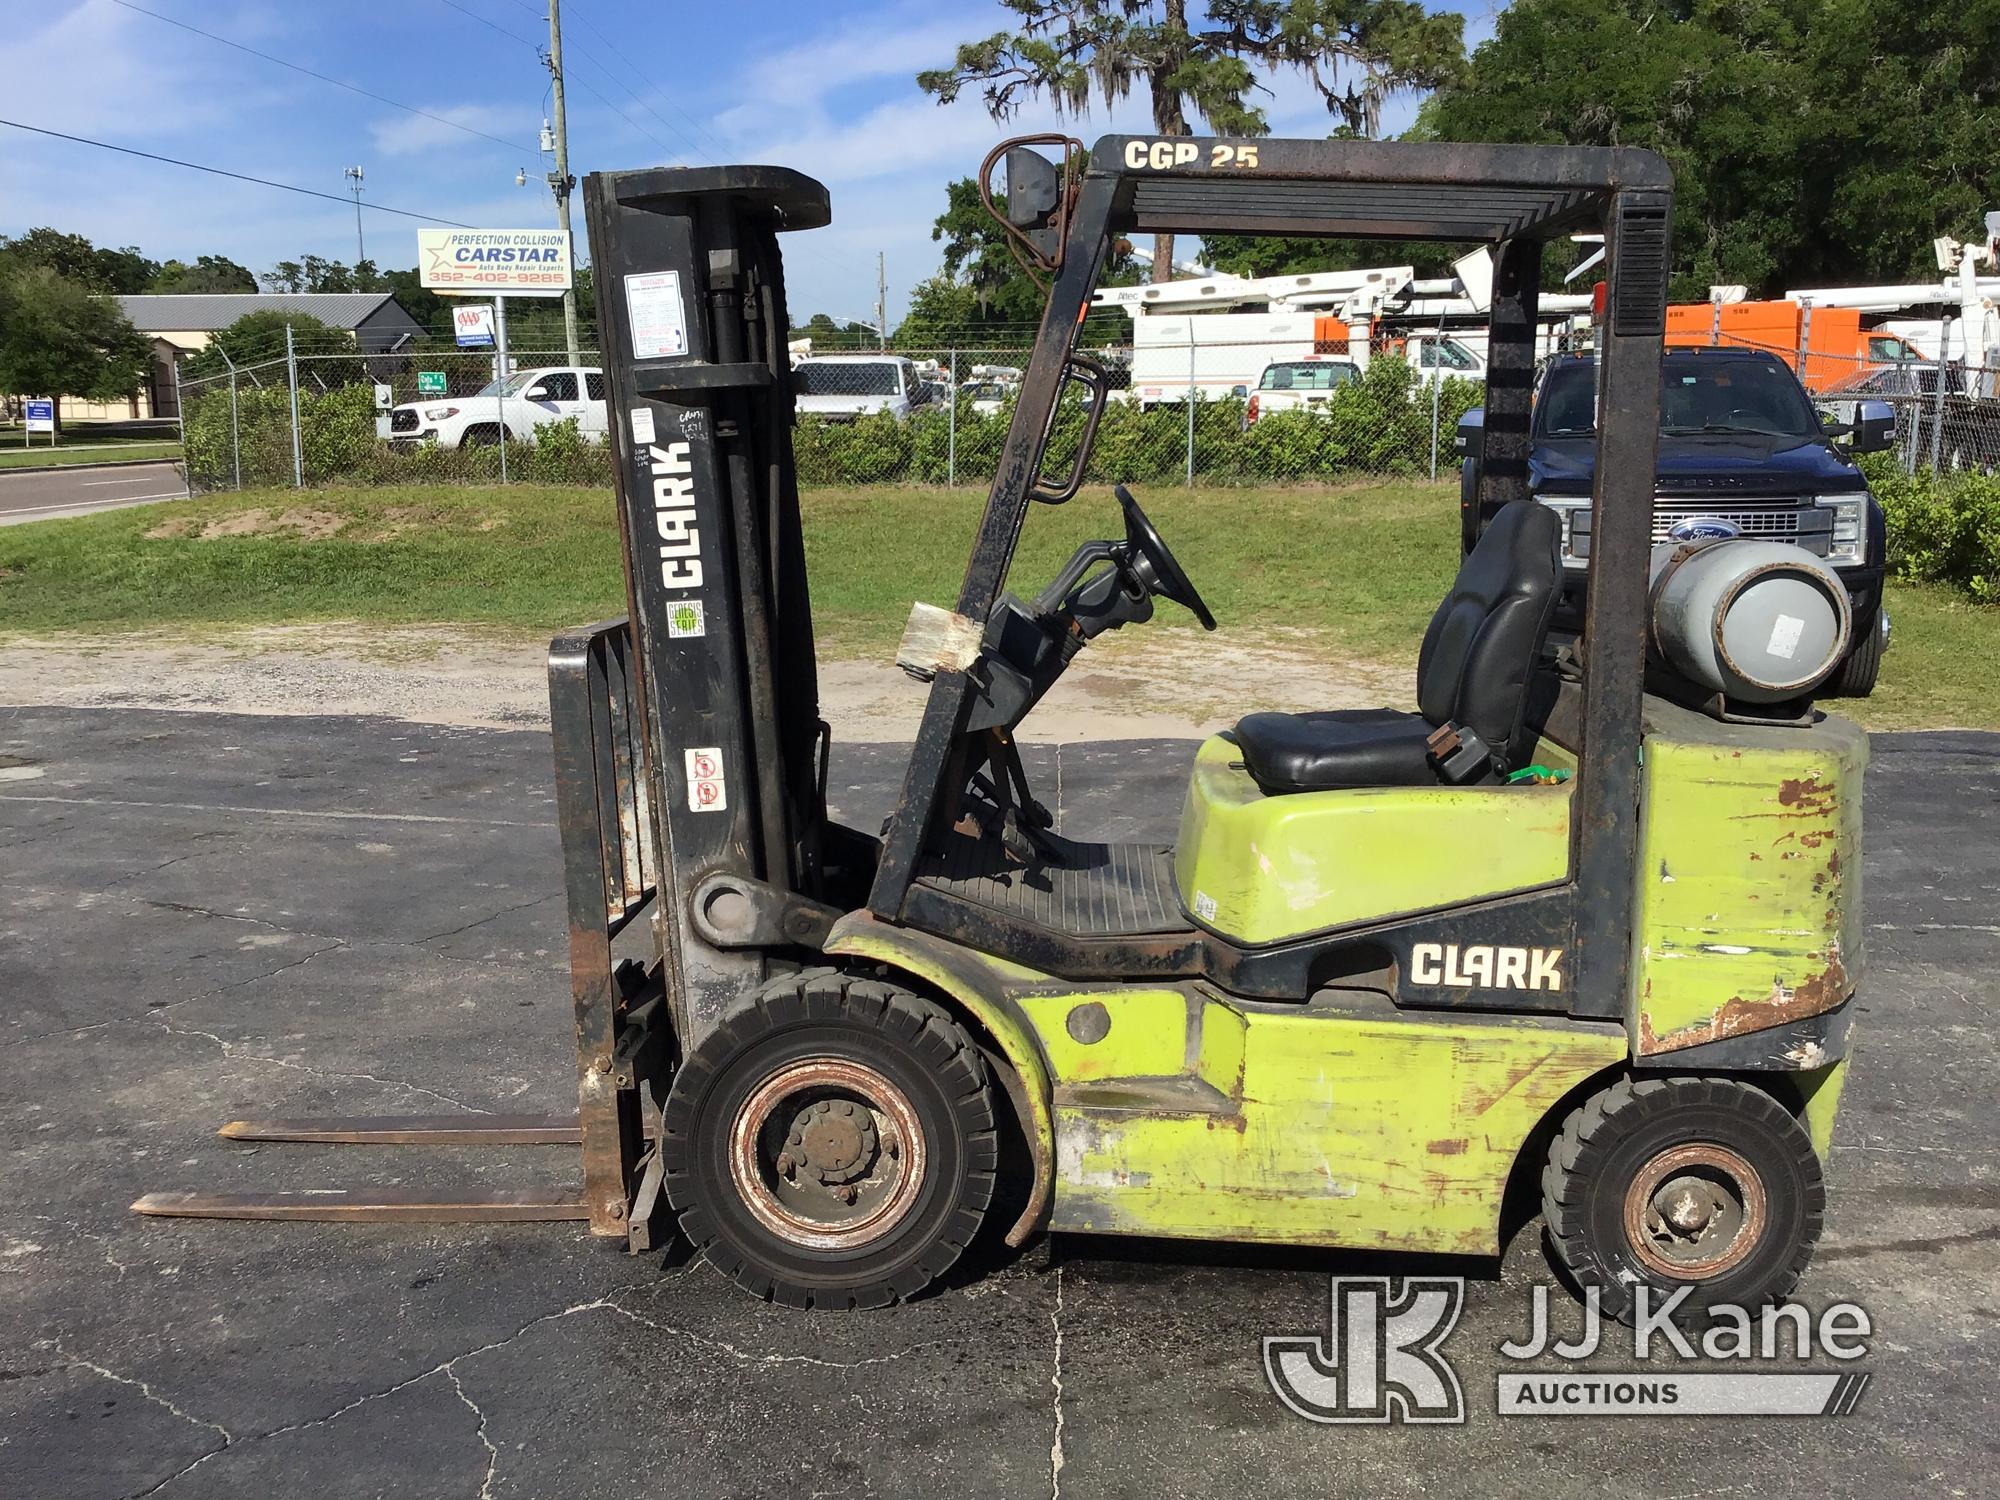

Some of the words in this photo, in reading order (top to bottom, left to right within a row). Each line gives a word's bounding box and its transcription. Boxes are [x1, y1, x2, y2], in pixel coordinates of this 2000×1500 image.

[1125, 140, 1199, 170] CGP
[1211, 144, 1259, 169] 25
[451, 234, 511, 245] PERFECTION
[513, 235, 564, 246] COLLISION
[455, 247, 559, 262] CARSTAR
[496, 264, 512, 272] Body
[515, 264, 536, 272] Repair
[429, 272, 565, 283] 352-402-9285
[1118, 291, 1138, 301] Altec
[459, 311, 479, 326] AAA
[649, 441, 704, 589] CLARK
[668, 602, 702, 619] GENESIS
[670, 619, 704, 636] SERIES
[1411, 943, 1563, 991] CLARK
